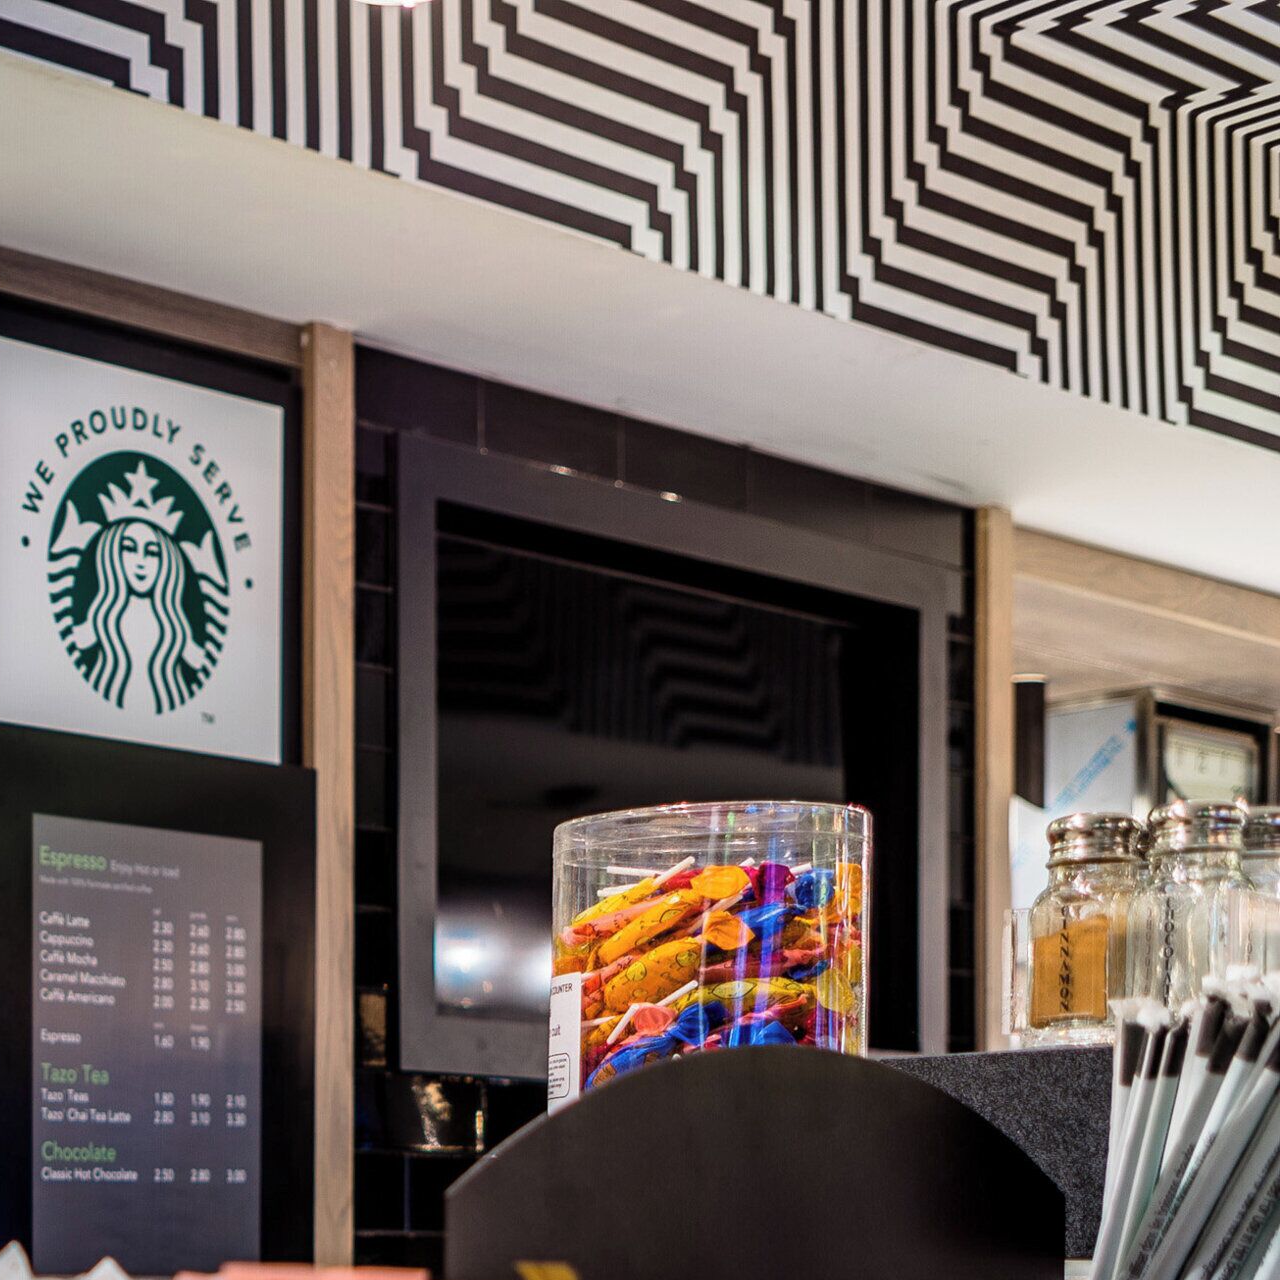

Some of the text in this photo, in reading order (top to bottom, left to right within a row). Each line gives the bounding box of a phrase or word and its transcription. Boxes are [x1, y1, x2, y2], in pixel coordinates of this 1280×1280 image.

[22, 406, 251, 553] WE PROUDLY SERVE
[40, 845, 107, 871] Espresso
[67, 914, 90, 928] Latte
[40, 930, 94, 947] Cappuccino
[68, 952, 98, 967] Mocha
[1059, 905, 1071, 1012] CINNAMON
[40, 969, 78, 984] Caramel
[80, 971, 127, 988] Macchiato
[67, 990, 116, 1006] Americano
[41, 1028, 82, 1045] Espresso
[41, 1063, 109, 1085] Tazo Tea
[41, 1087, 64, 1102] Tazo
[66, 1088, 89, 1103] Teas
[41, 1107, 64, 1121] Tazo
[66, 1107, 88, 1122] Chai
[90, 1108, 107, 1122] Tea
[109, 1109, 131, 1123] Latte
[41, 1141, 116, 1162] Chocolate
[41, 1166, 72, 1181] Classic
[74, 1167, 91, 1181] Hot
[93, 1167, 138, 1182] Chocolate
